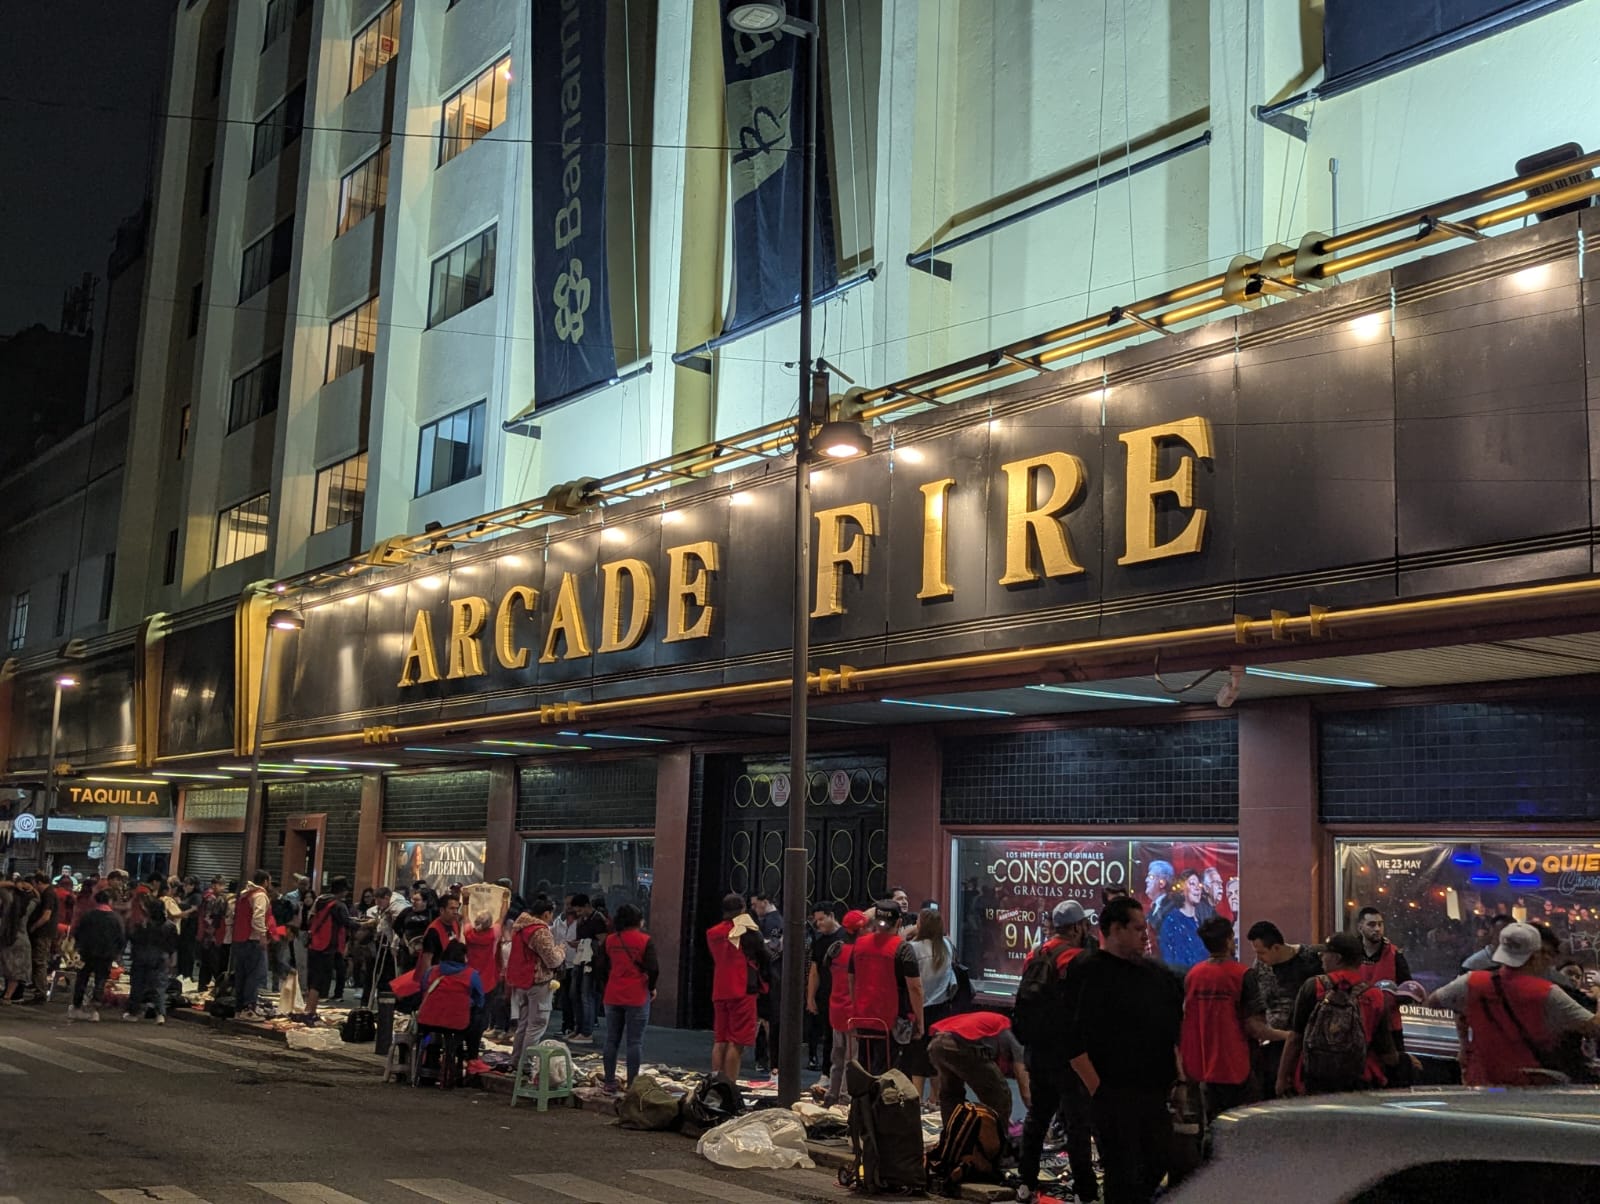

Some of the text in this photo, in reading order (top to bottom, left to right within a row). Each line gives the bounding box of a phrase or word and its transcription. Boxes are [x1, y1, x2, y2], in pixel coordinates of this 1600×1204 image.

[397, 415, 1215, 688] ARCADE FIRE
[69, 788, 159, 805] TAQUILLA
[1006, 851, 1018, 859] LOS
[1063, 851, 1104, 860] ORIGINALES
[428, 861, 475, 876] LIBERTAD
[1376, 859, 1422, 869] VIE 23 MAY
[1504, 853, 1600, 874] YO QUIE
[987, 859, 1125, 885] EL CONSORCIO
[1013, 885, 1094, 898] GRACIAS 2025
[985, 908, 994, 920] 13
[1005, 923, 1042, 949] 9 M
[1008, 952, 1026, 960] TEATR
[1409, 1005, 1454, 1019] METROPOLI
